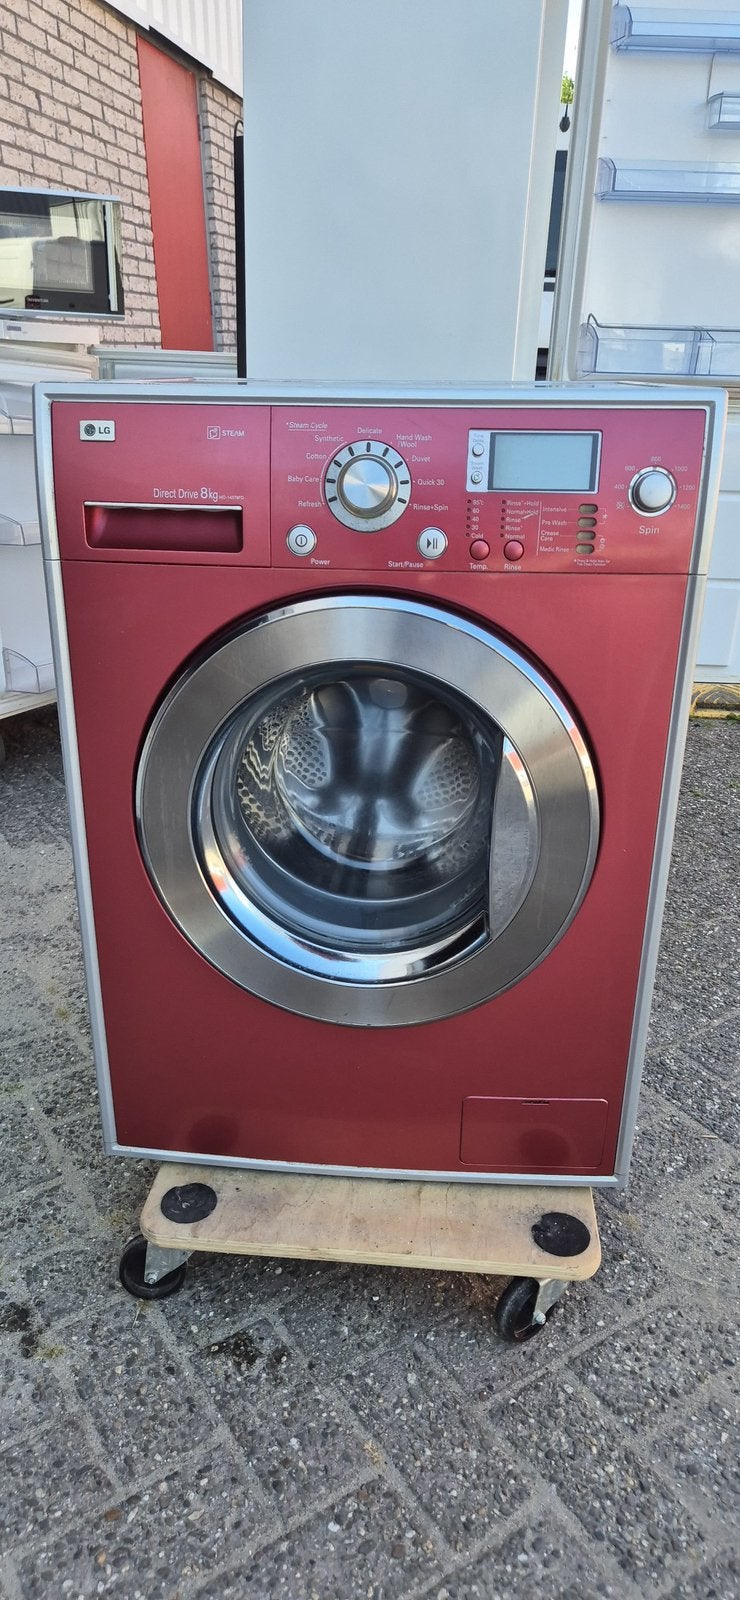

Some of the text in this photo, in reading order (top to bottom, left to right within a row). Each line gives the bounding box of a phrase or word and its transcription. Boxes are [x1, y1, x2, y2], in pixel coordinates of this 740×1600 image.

[310, 422, 328, 430] Cycle
[357, 426, 382, 434] Delicate
[98, 426, 111, 435] LG
[314, 434, 344, 442] Synthetic
[306, 452, 327, 460] Cotton
[411, 455, 431, 463] Duvet
[287, 475, 319, 483] Baby Care
[153, 488, 177, 499] Direct
[178, 489, 199, 499] Drive
[412, 504, 449, 512] Rinse+Spin
[639, 525, 660, 535] Spin
[310, 557, 330, 566] Power
[388, 560, 424, 569] Start/Pause
[469, 563, 489, 571] Temp.
